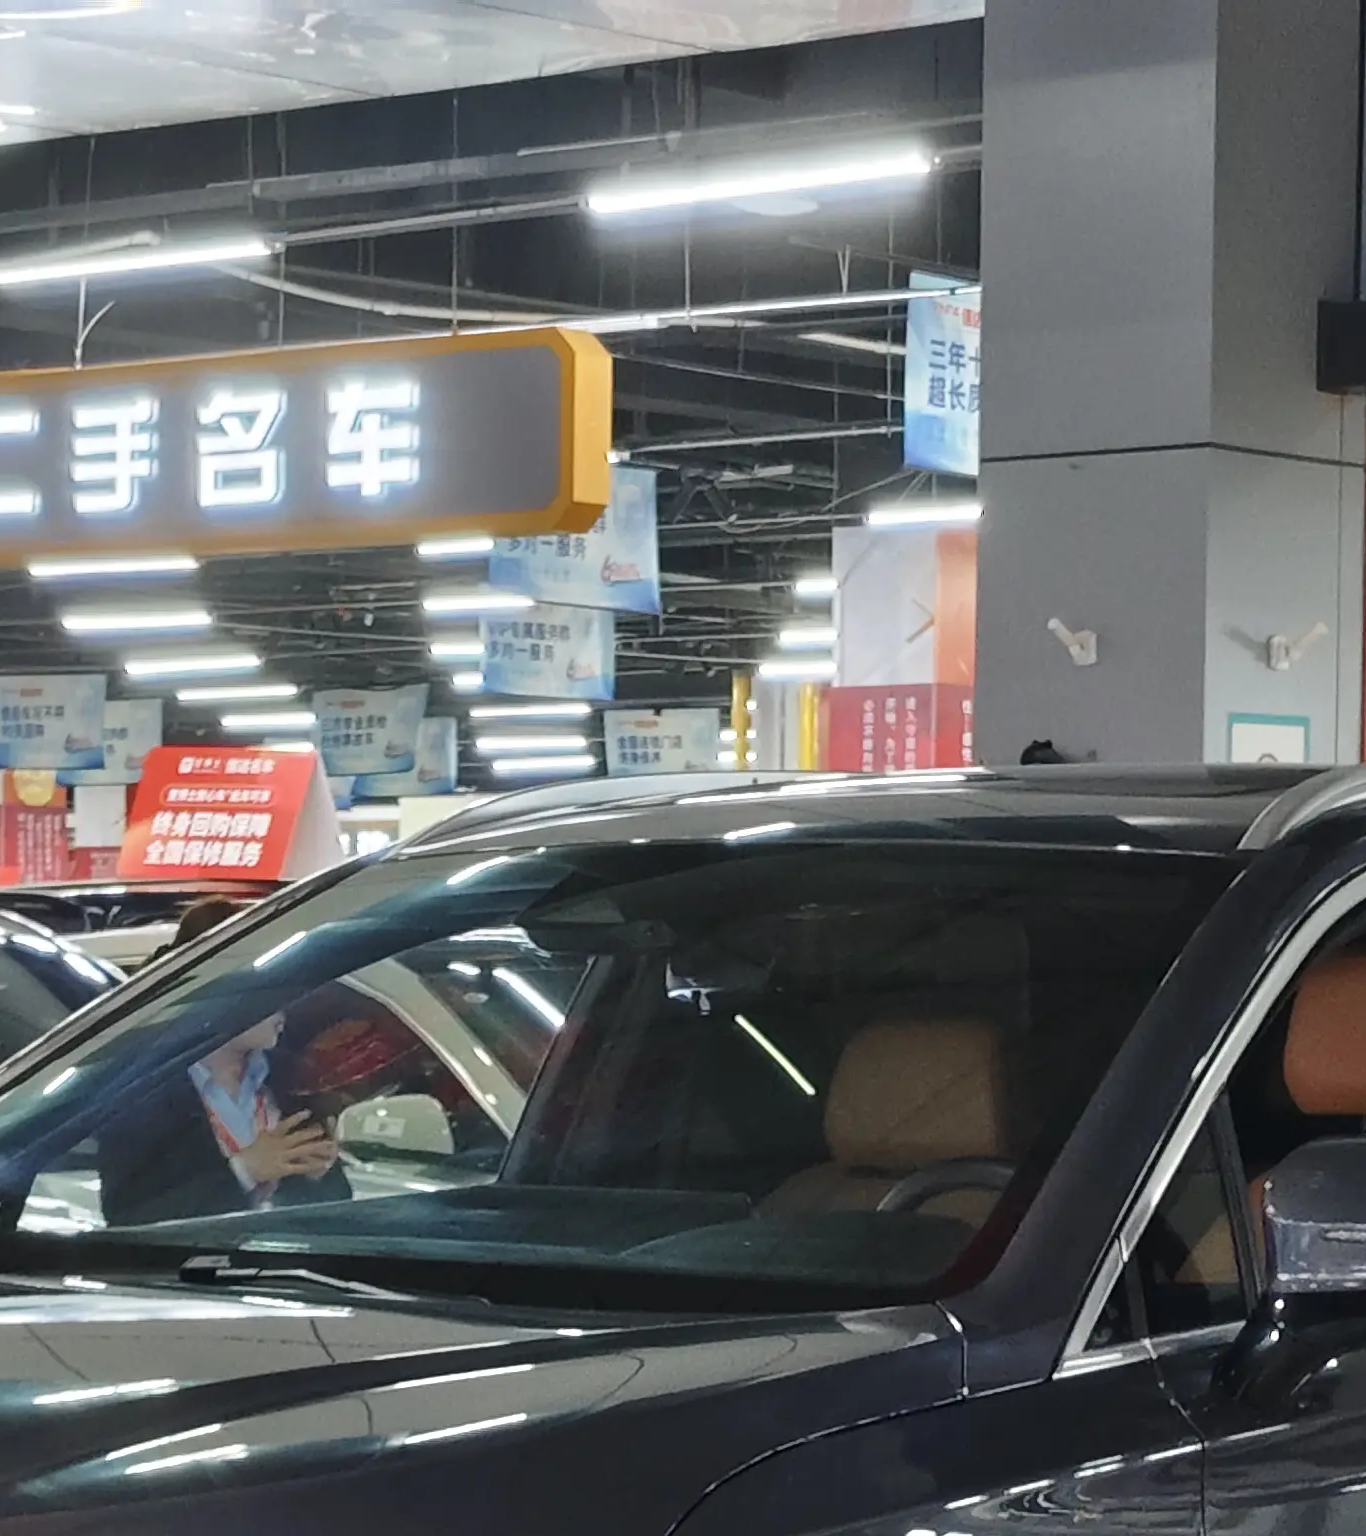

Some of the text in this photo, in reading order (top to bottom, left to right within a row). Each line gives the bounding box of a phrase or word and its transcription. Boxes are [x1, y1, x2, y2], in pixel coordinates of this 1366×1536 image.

[151, 811, 274, 838] 终身回购保障
[143, 839, 264, 867] 全国保修服务
